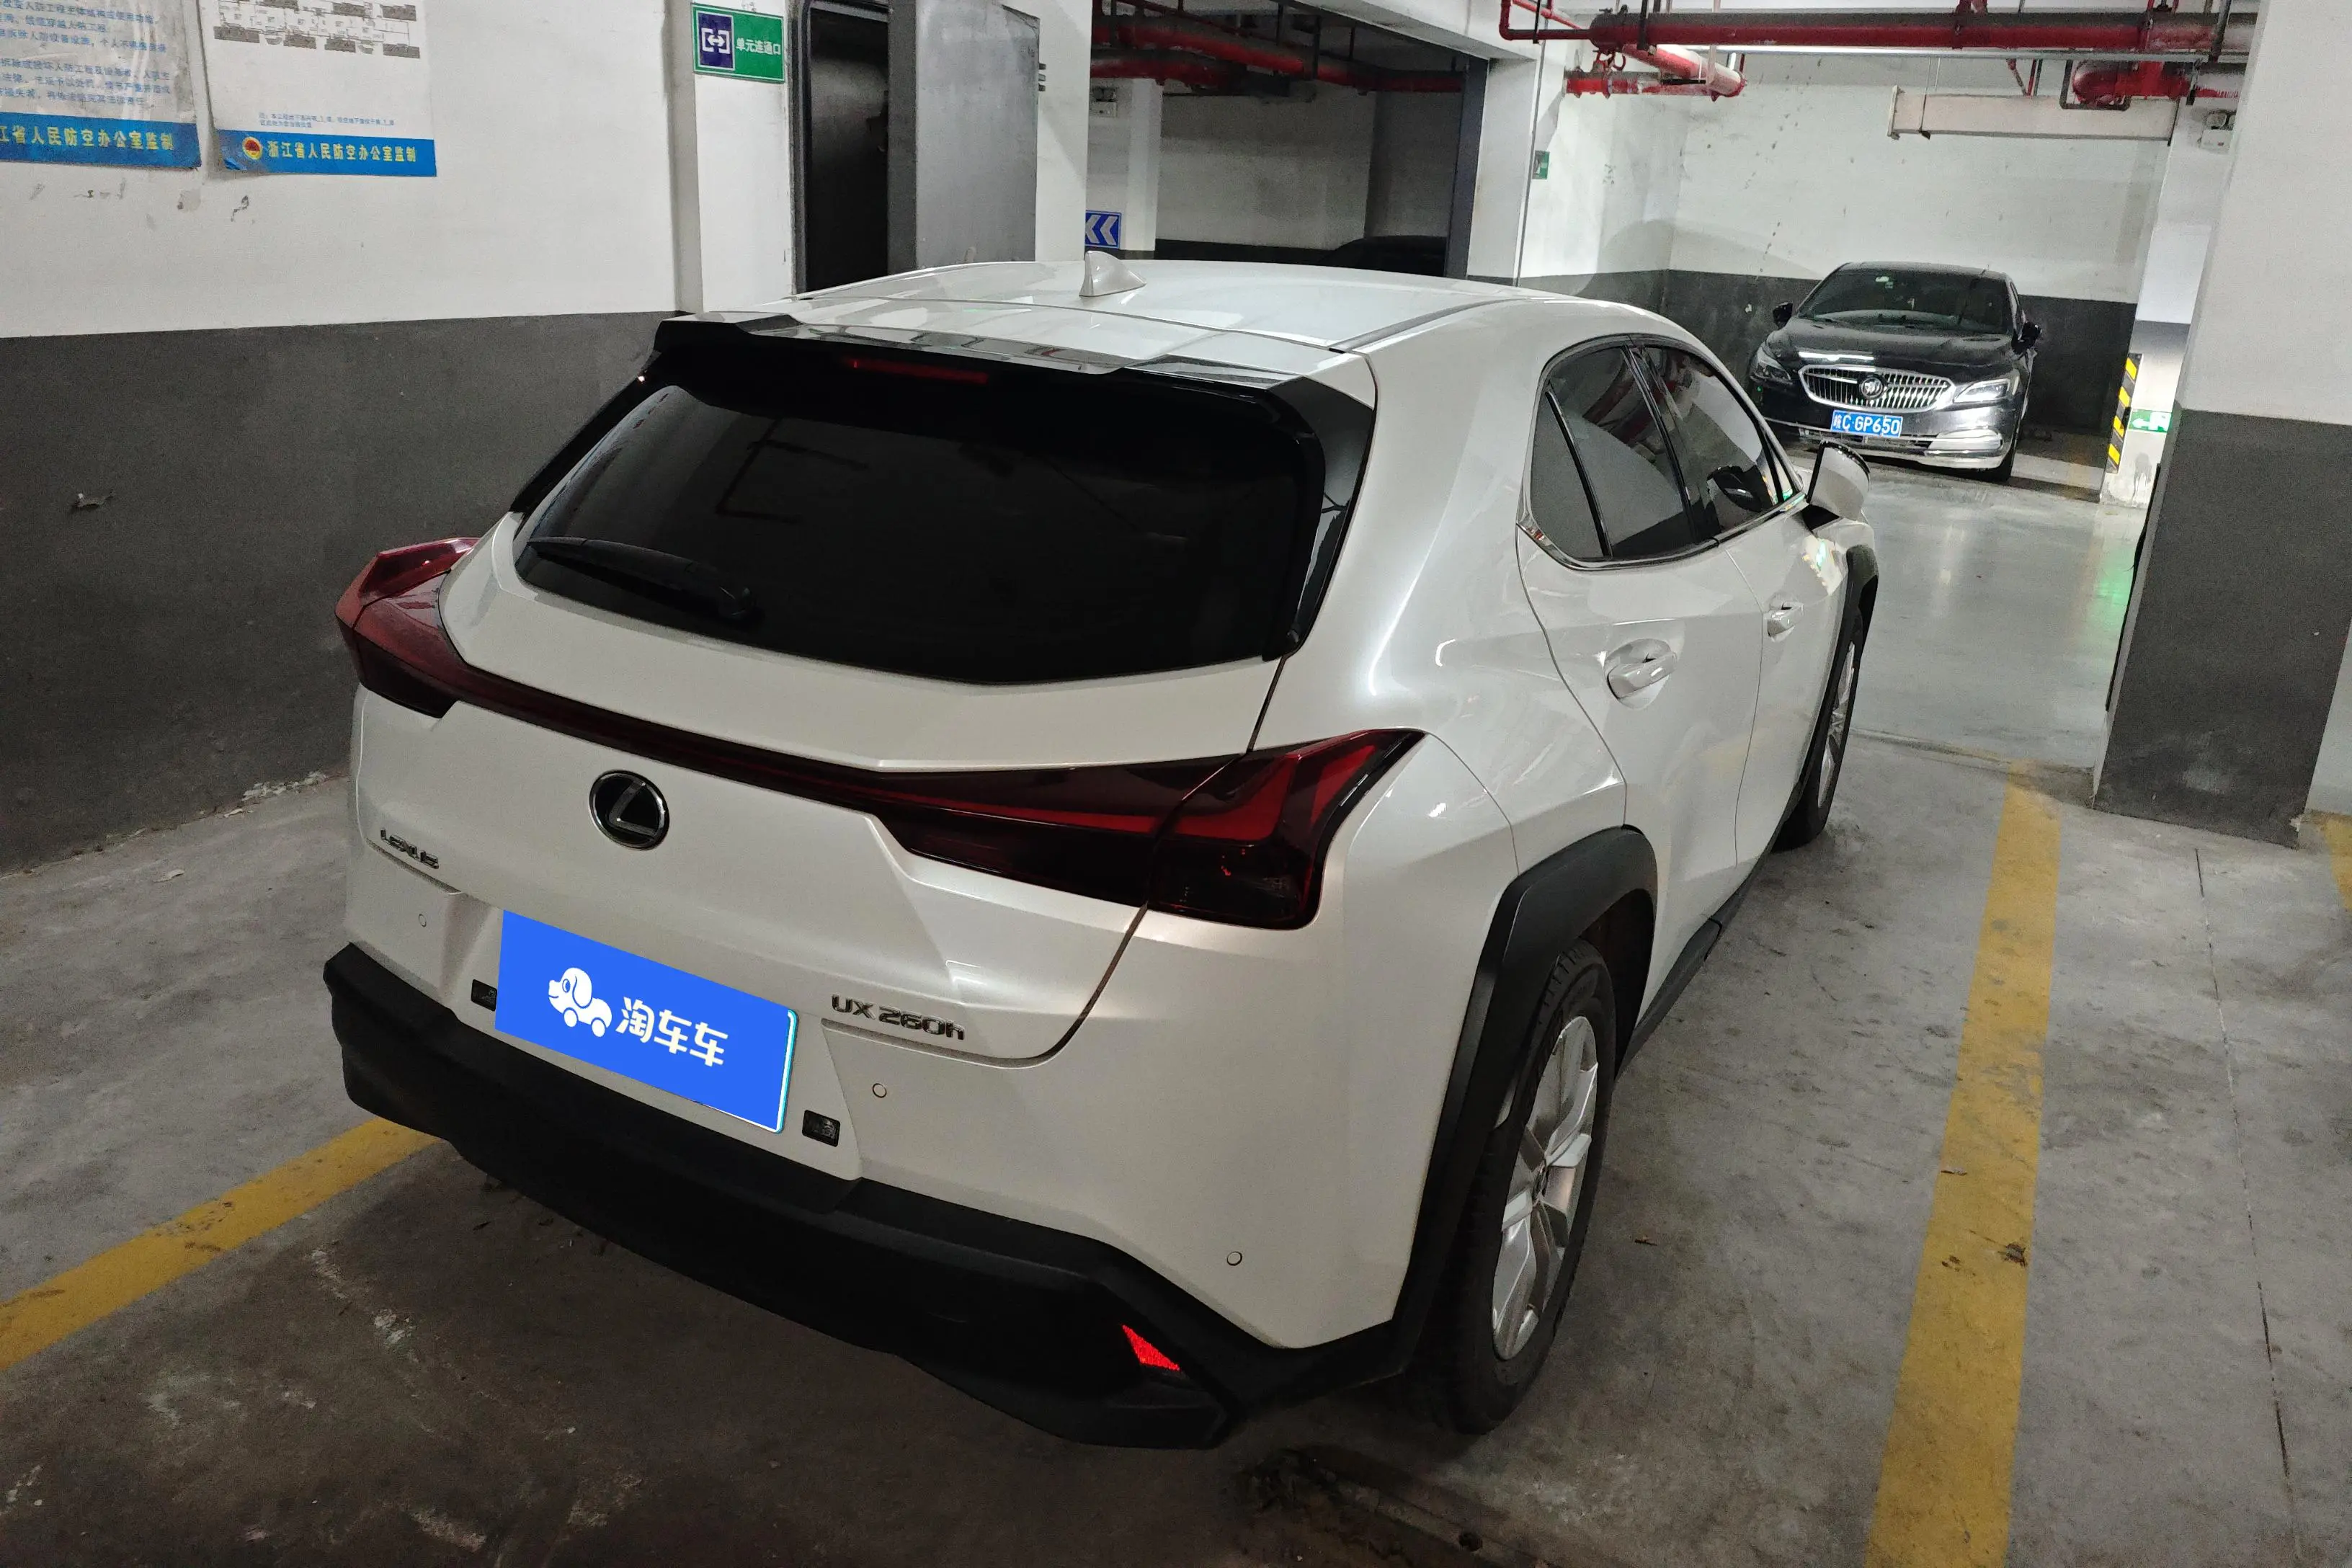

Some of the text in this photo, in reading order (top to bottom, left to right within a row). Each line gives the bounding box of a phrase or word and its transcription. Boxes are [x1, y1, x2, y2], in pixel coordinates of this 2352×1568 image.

[267, 141, 416, 162] 浙江省人民防空办公室监制
[832, 992, 966, 1041] UX 260h
